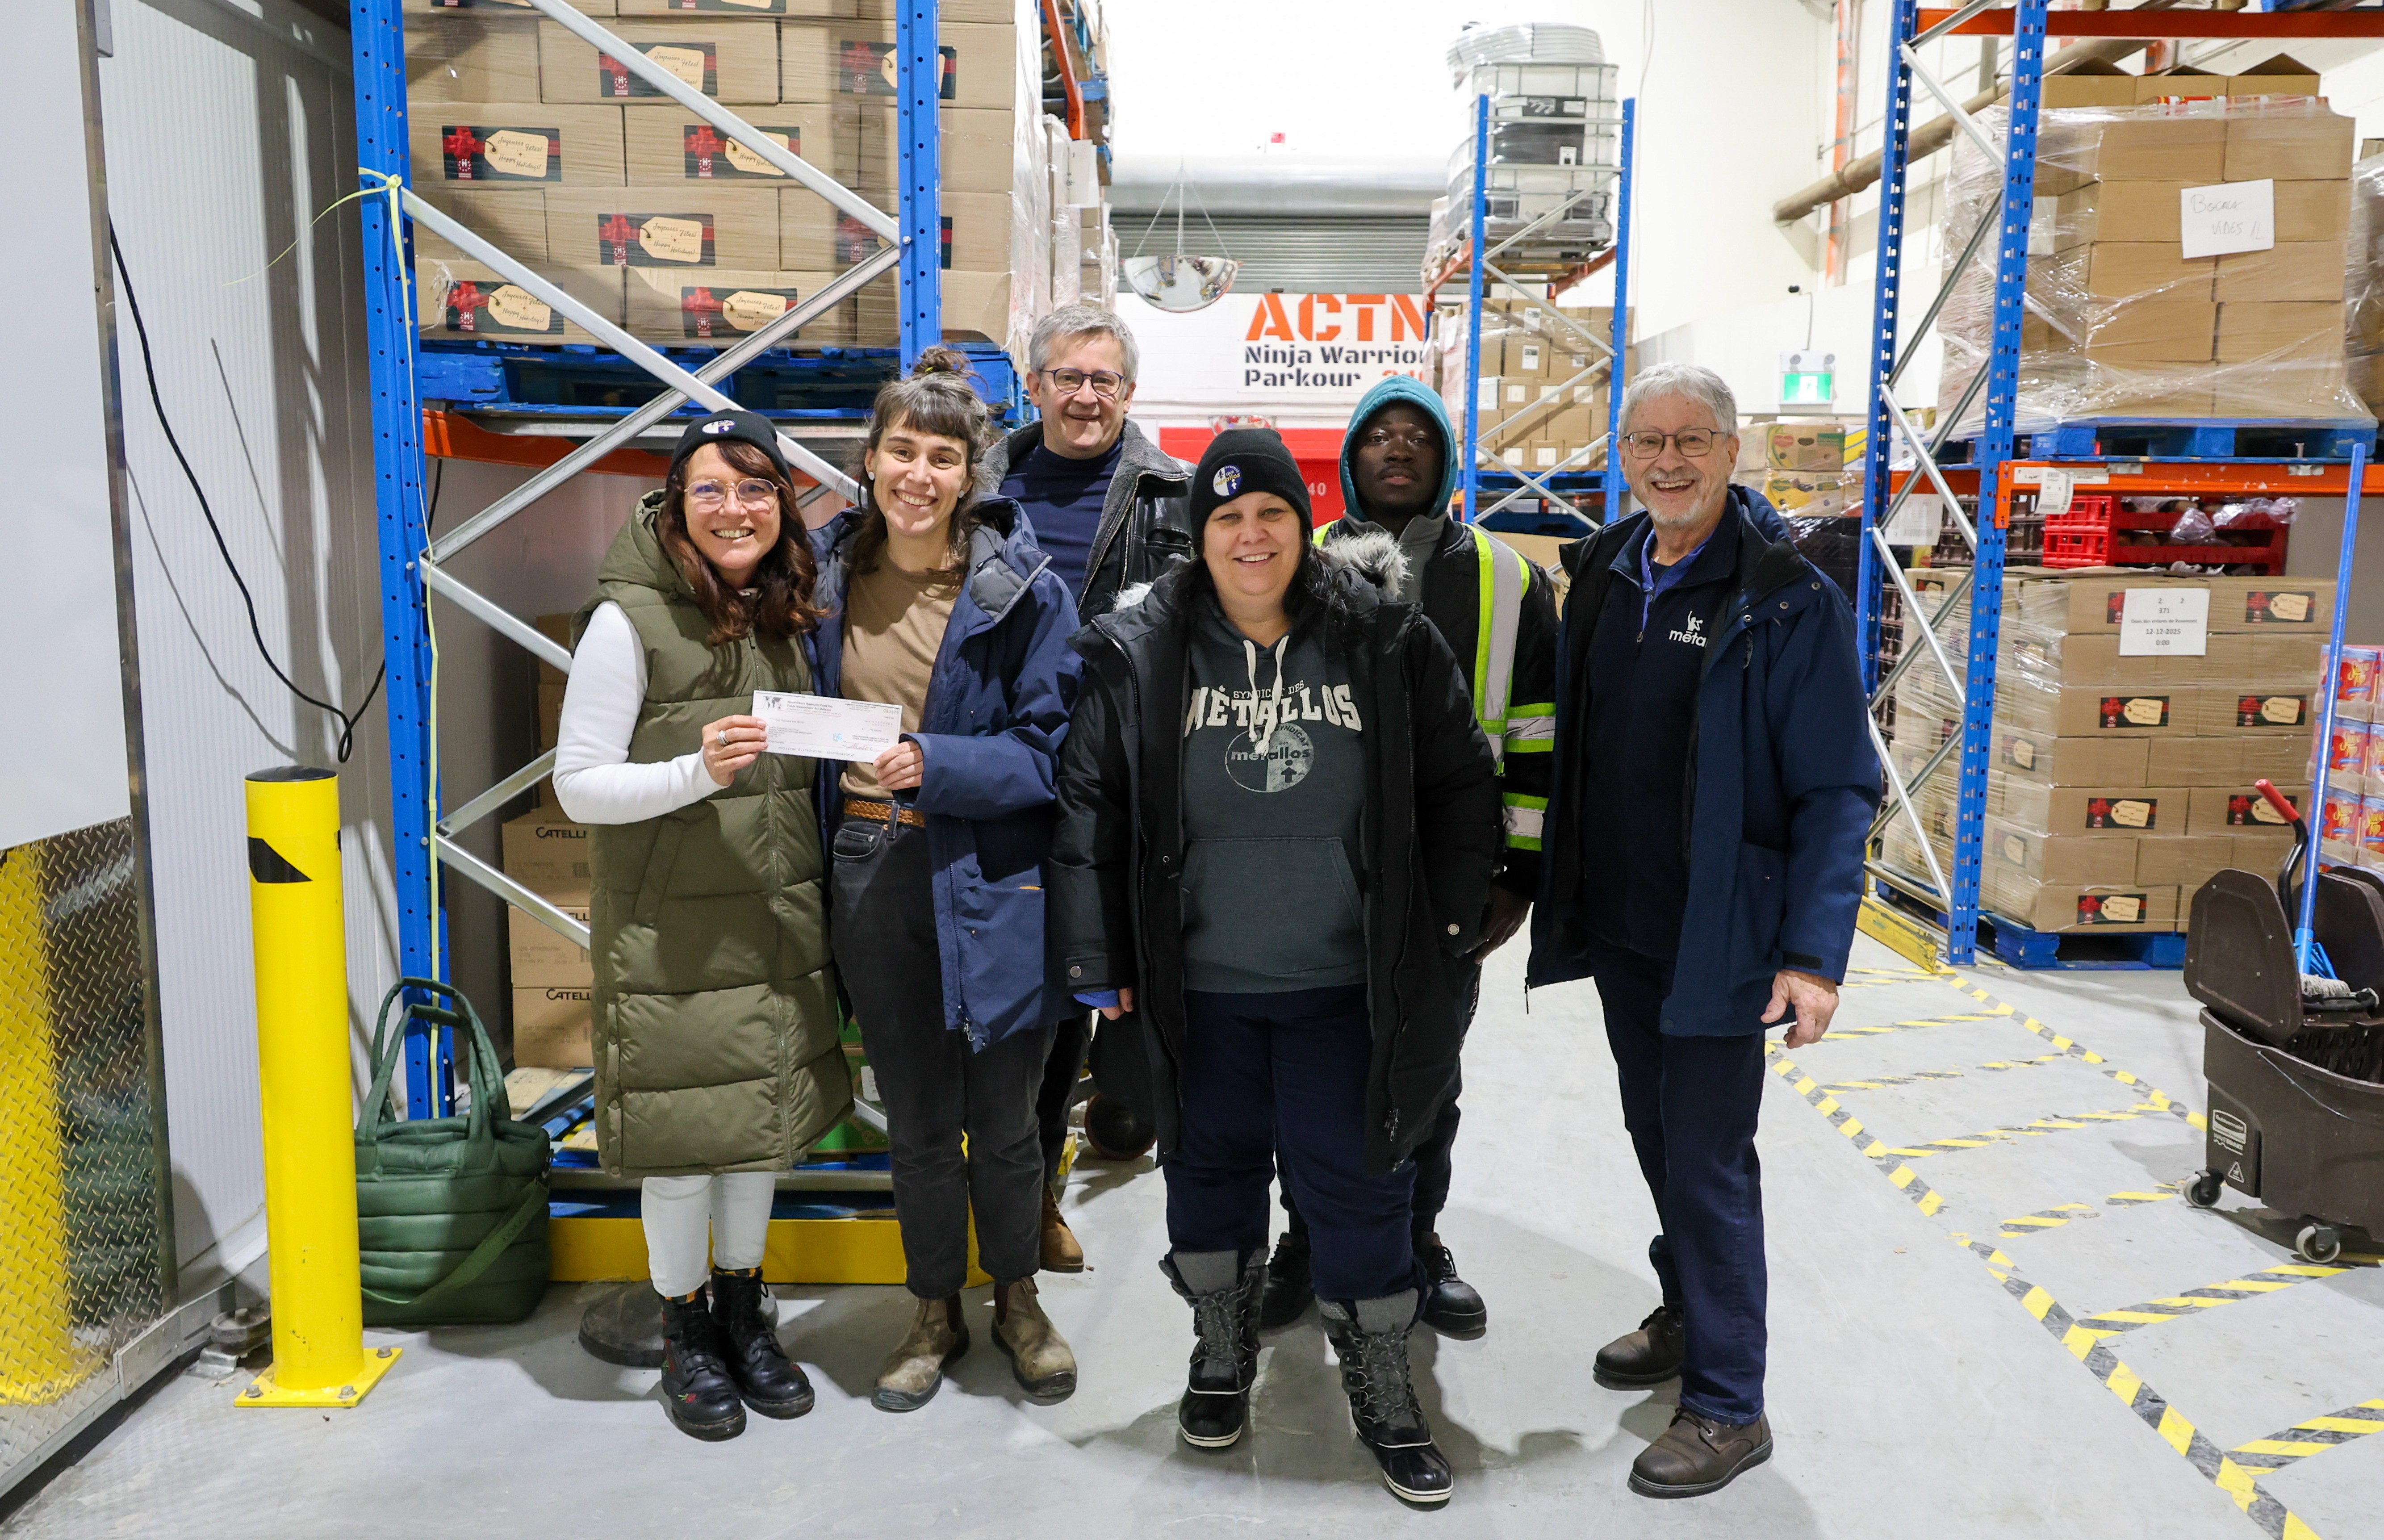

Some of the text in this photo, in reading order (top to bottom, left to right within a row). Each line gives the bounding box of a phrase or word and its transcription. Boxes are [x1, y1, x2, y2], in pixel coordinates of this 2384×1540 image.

[1245, 344, 1312, 368] Ninja
[1245, 368, 1361, 387] Parkour
[1308, 482, 1326, 497] 40
[1669, 630, 1707, 648] méta
[1288, 680, 1305, 695] DES
[535, 827, 586, 839] CATELLI
[546, 988, 590, 1000] CATELL
